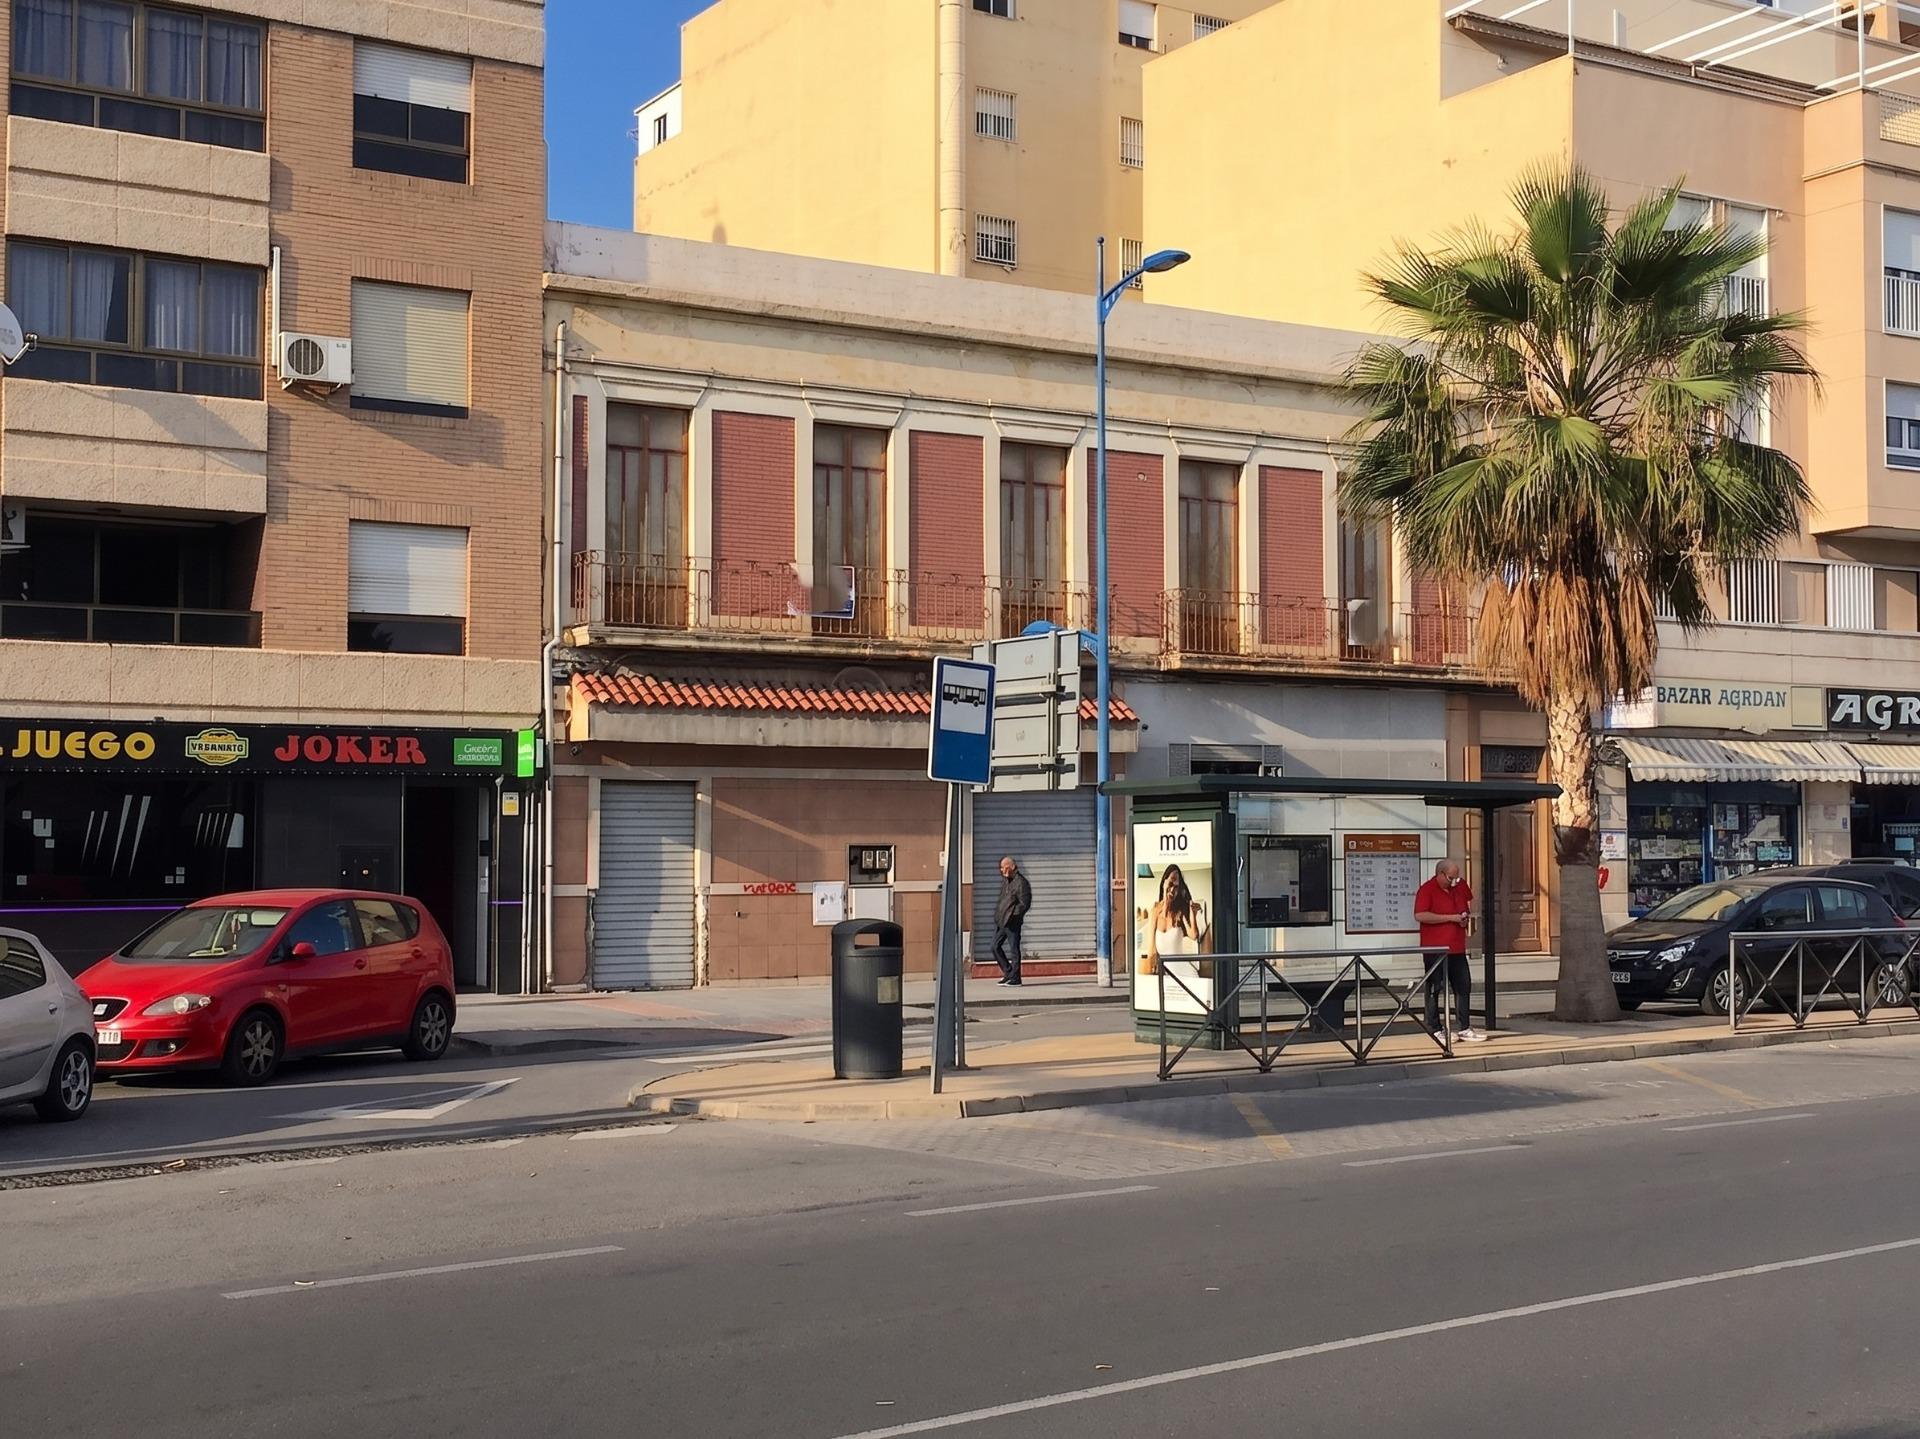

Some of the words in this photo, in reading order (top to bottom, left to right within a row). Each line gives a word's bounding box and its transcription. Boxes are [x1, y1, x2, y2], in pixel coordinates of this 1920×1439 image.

[1657, 686, 1712, 705] BAZAR
[1718, 689, 1787, 710] AGRDAN
[1831, 694, 1920, 731] AGR
[12, 729, 156, 760] JUEGO
[274, 735, 427, 764] JOKER
[1160, 826, 1188, 851] mó
